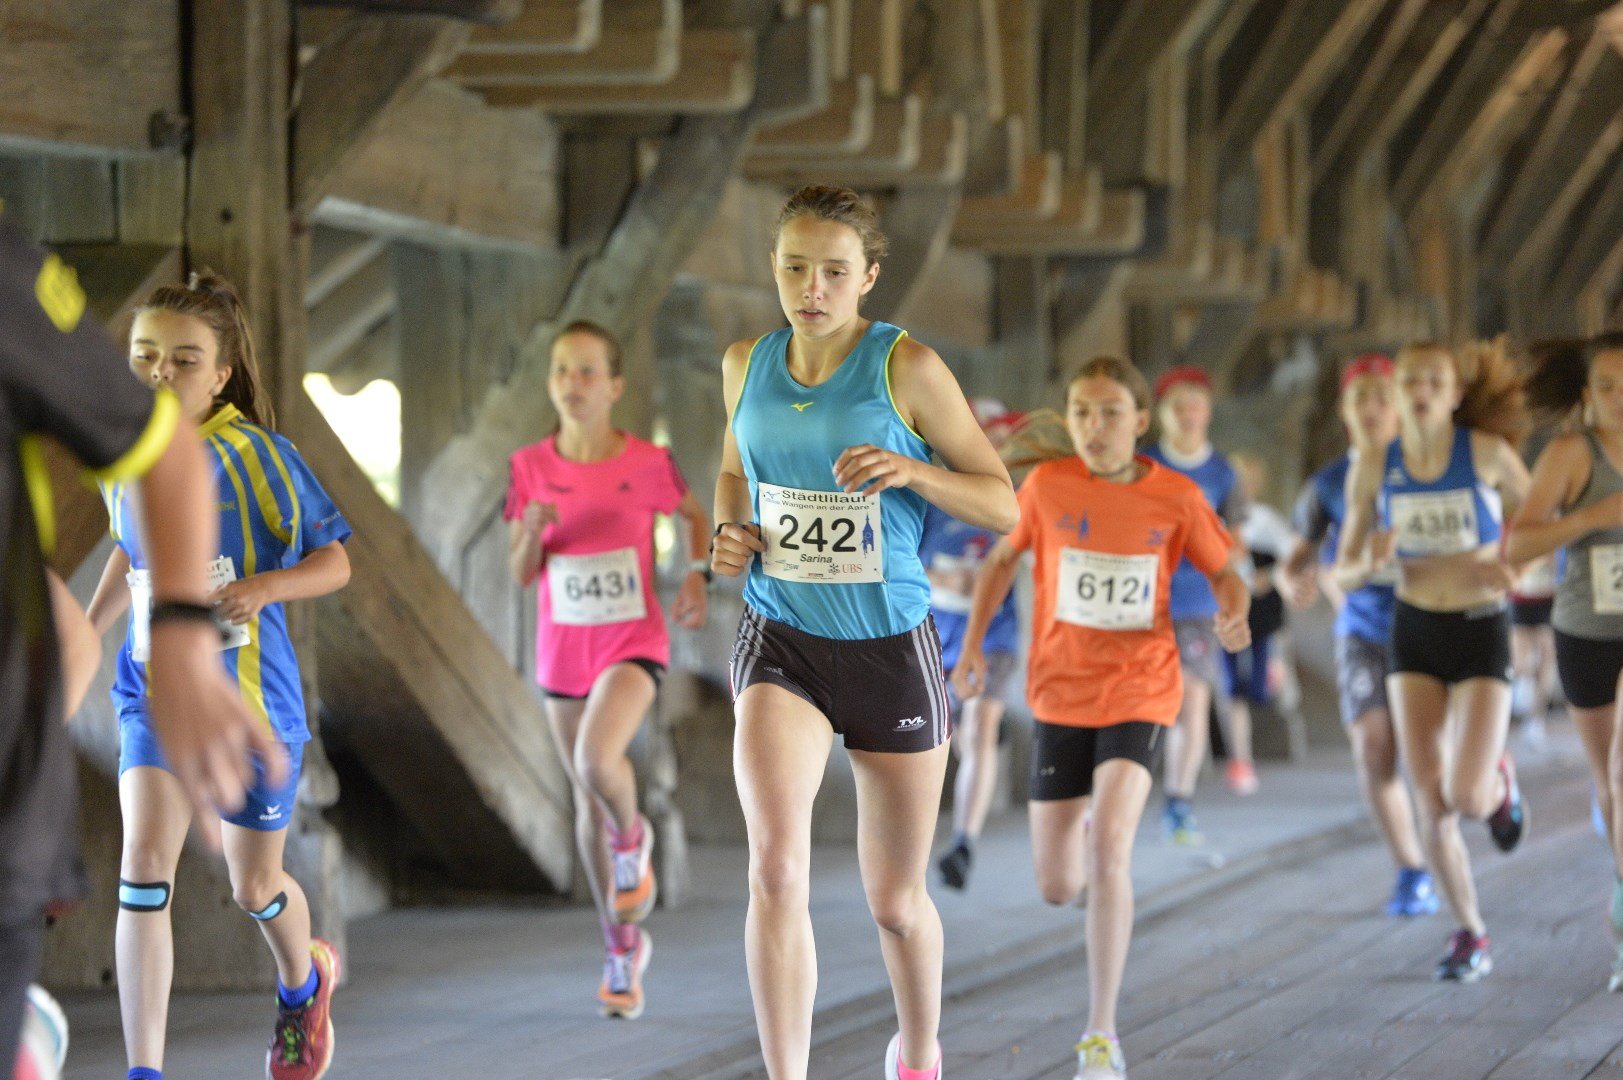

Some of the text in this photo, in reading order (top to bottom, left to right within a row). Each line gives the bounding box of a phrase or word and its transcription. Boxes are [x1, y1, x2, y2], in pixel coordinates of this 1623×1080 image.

[782, 500, 814, 510] Wangen
[779, 514, 857, 553] 242
[800, 553, 833, 564] Sarina
[842, 564, 863, 574] UBS
[564, 570, 624, 602] 643
[1077, 571, 1140, 605] 612
